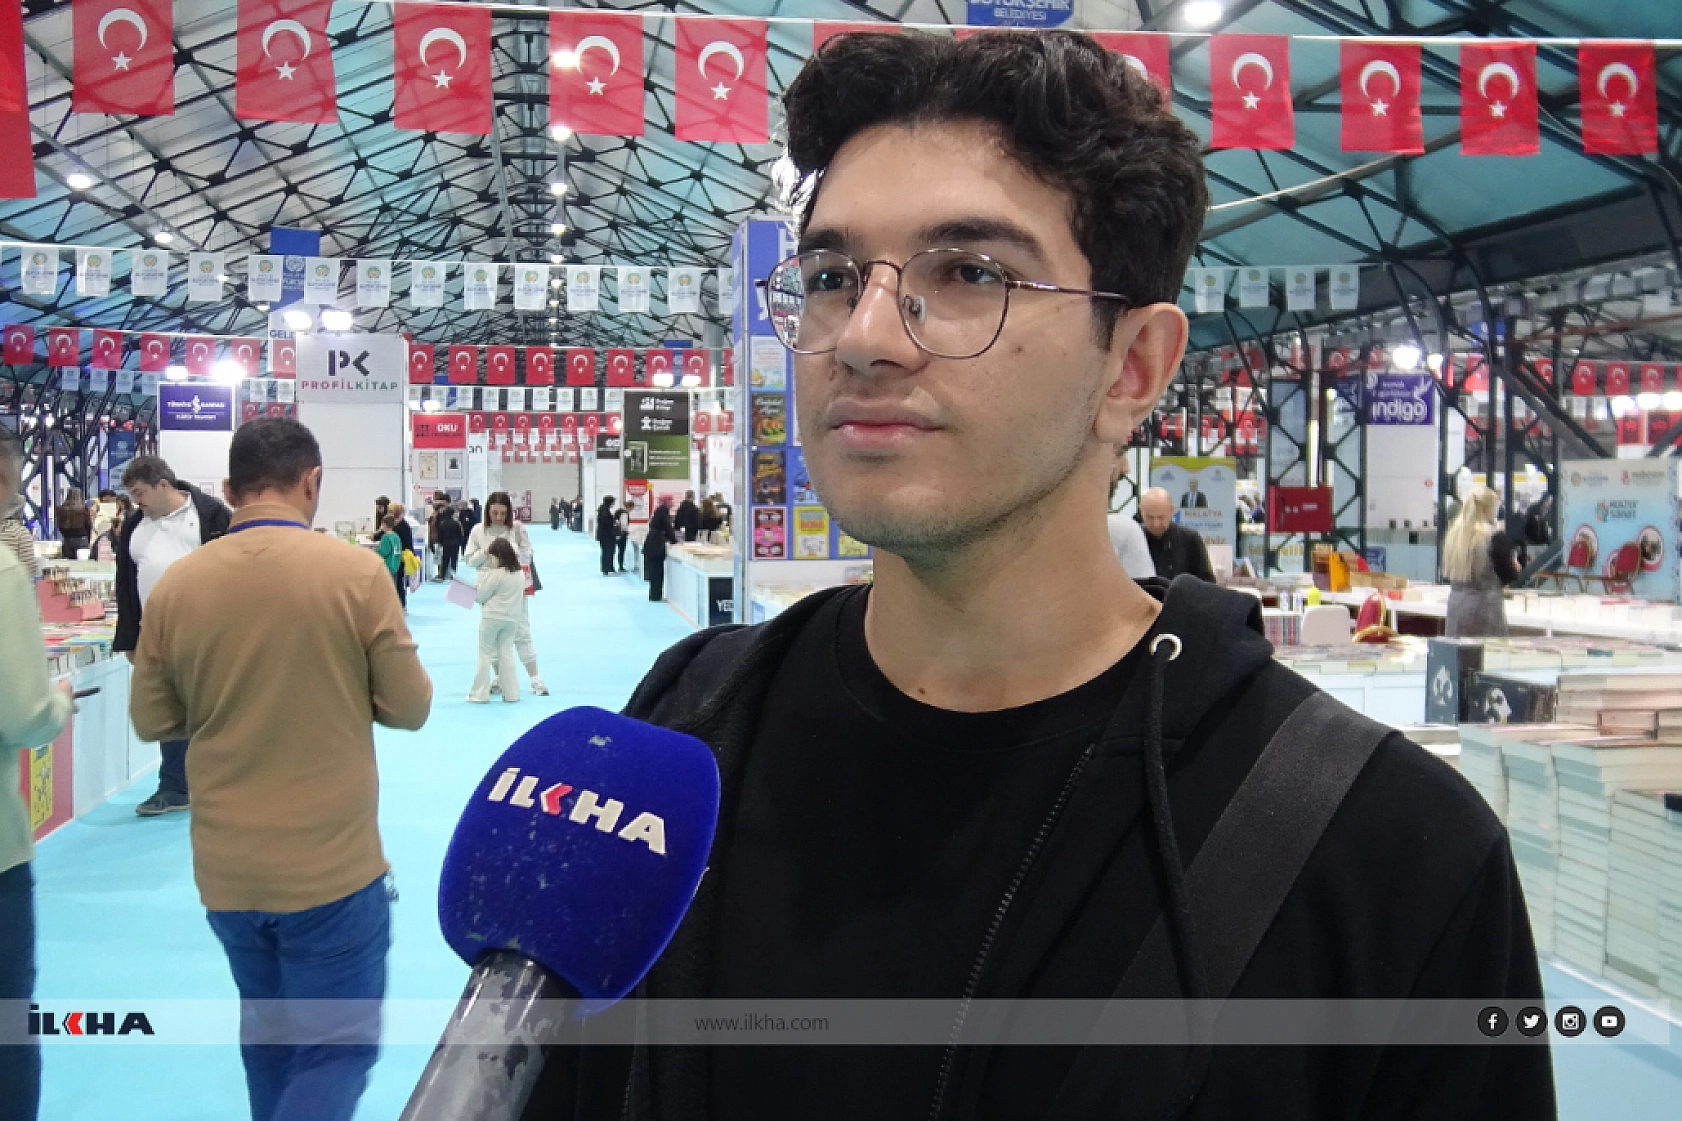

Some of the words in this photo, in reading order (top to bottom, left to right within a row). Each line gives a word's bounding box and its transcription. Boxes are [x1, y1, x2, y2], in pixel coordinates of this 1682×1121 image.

[994, 8, 1046, 20] BELEDİYESİ
[301, 378, 399, 390] PROFİLKİTAP
[1372, 400, 1427, 421] indigo
[437, 423, 457, 432] OKU
[487, 767, 666, 855] İLKHA
